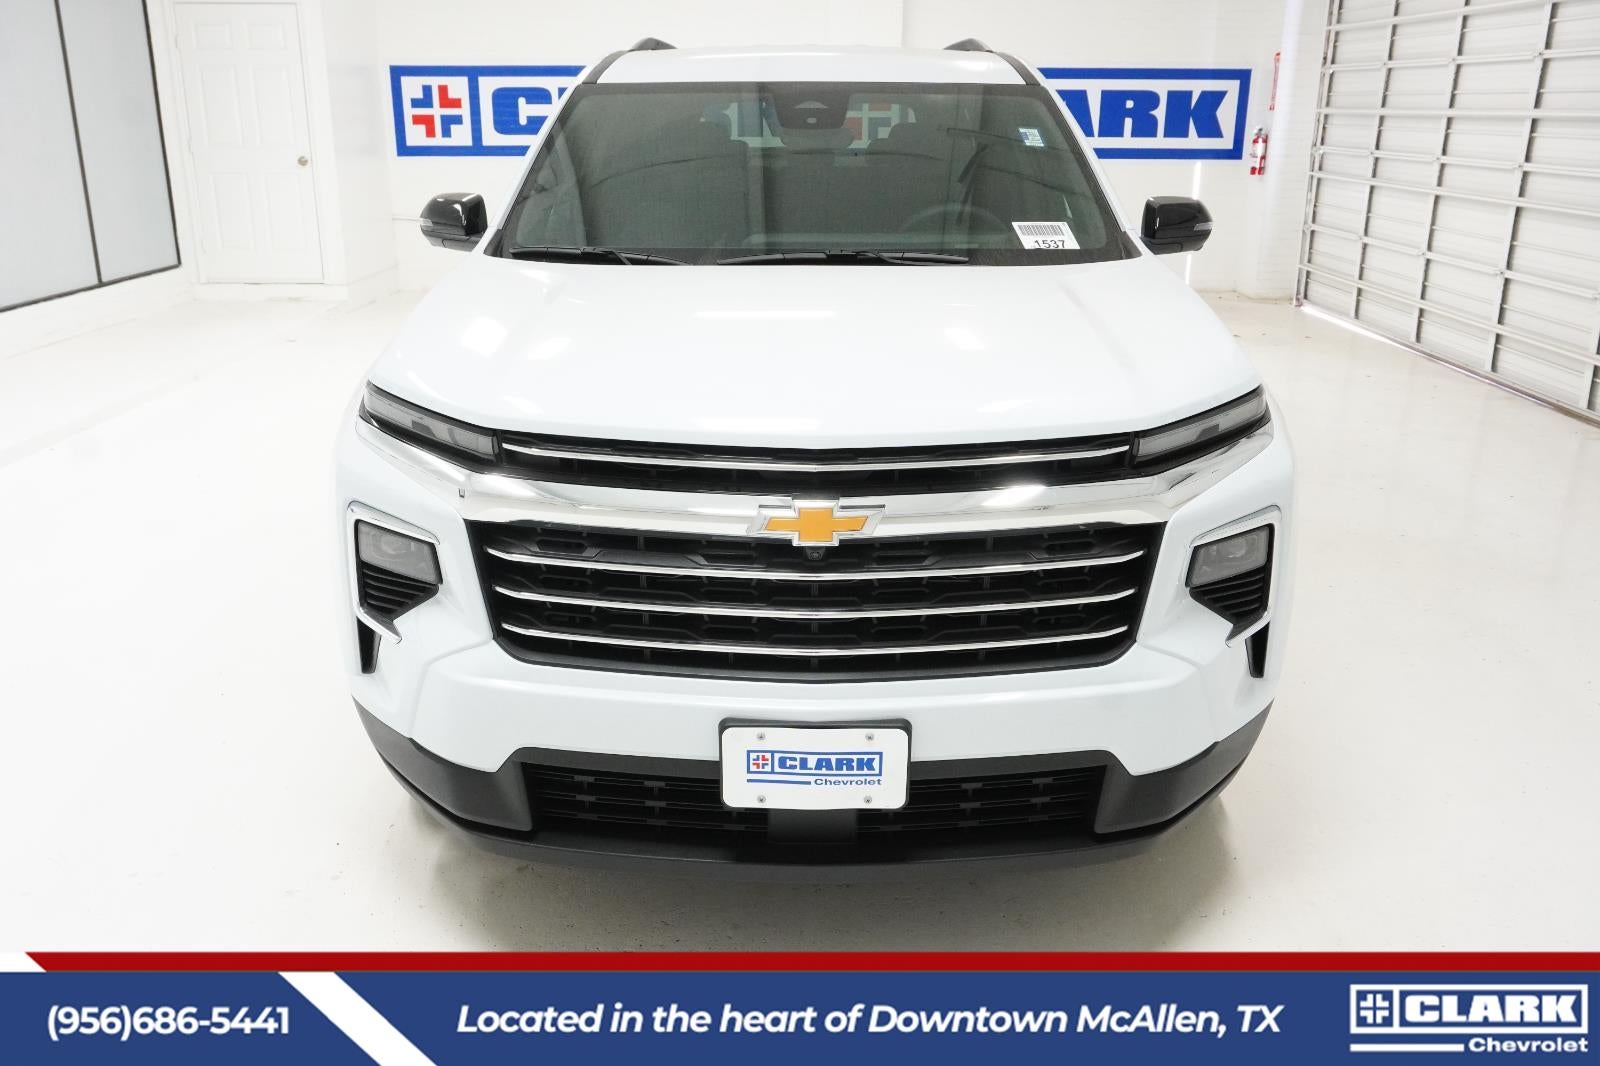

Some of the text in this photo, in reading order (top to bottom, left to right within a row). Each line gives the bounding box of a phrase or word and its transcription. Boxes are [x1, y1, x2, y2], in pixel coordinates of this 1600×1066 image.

[1034, 239, 1065, 249] 1537
[777, 756, 876, 771] CLARK
[814, 778, 882, 786] Chevrolet
